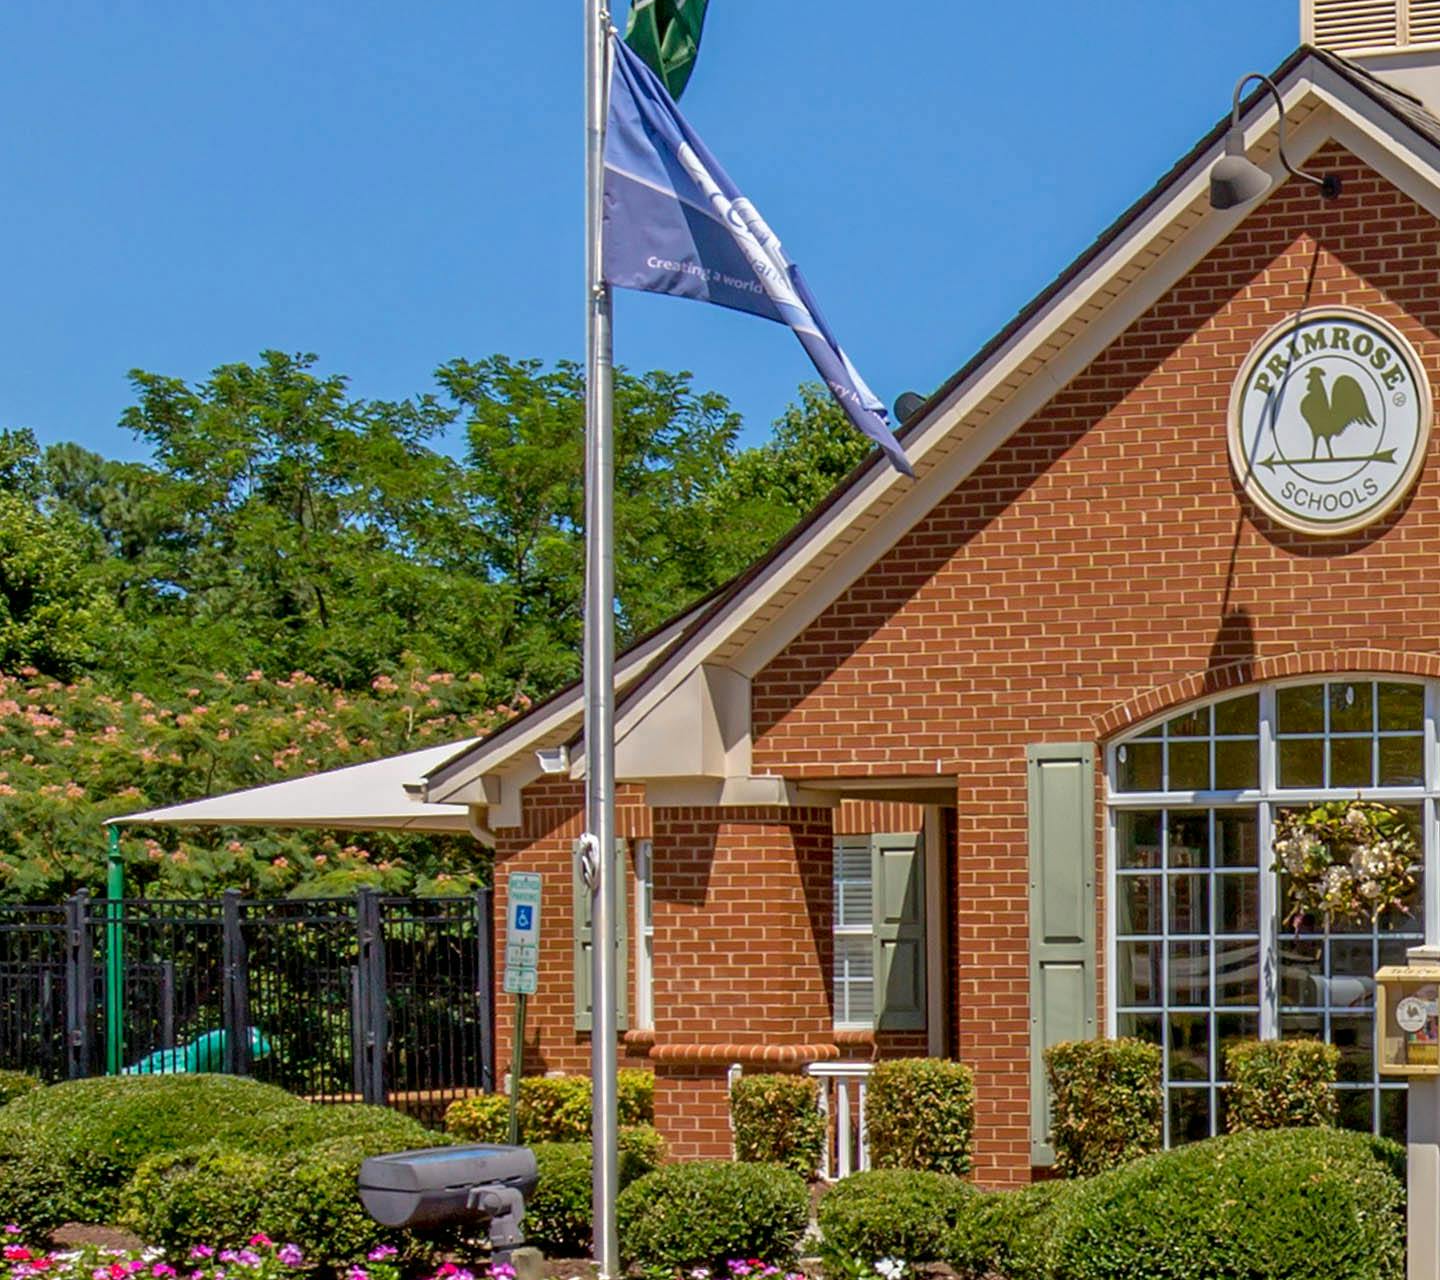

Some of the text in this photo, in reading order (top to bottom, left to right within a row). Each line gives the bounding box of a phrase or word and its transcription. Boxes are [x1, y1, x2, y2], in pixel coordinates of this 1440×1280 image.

[647, 256, 711, 281] Creating
[723, 274, 763, 294] world
[1254, 327, 1406, 395] PRIMROSE
[1281, 477, 1379, 512] SCHOOLS
